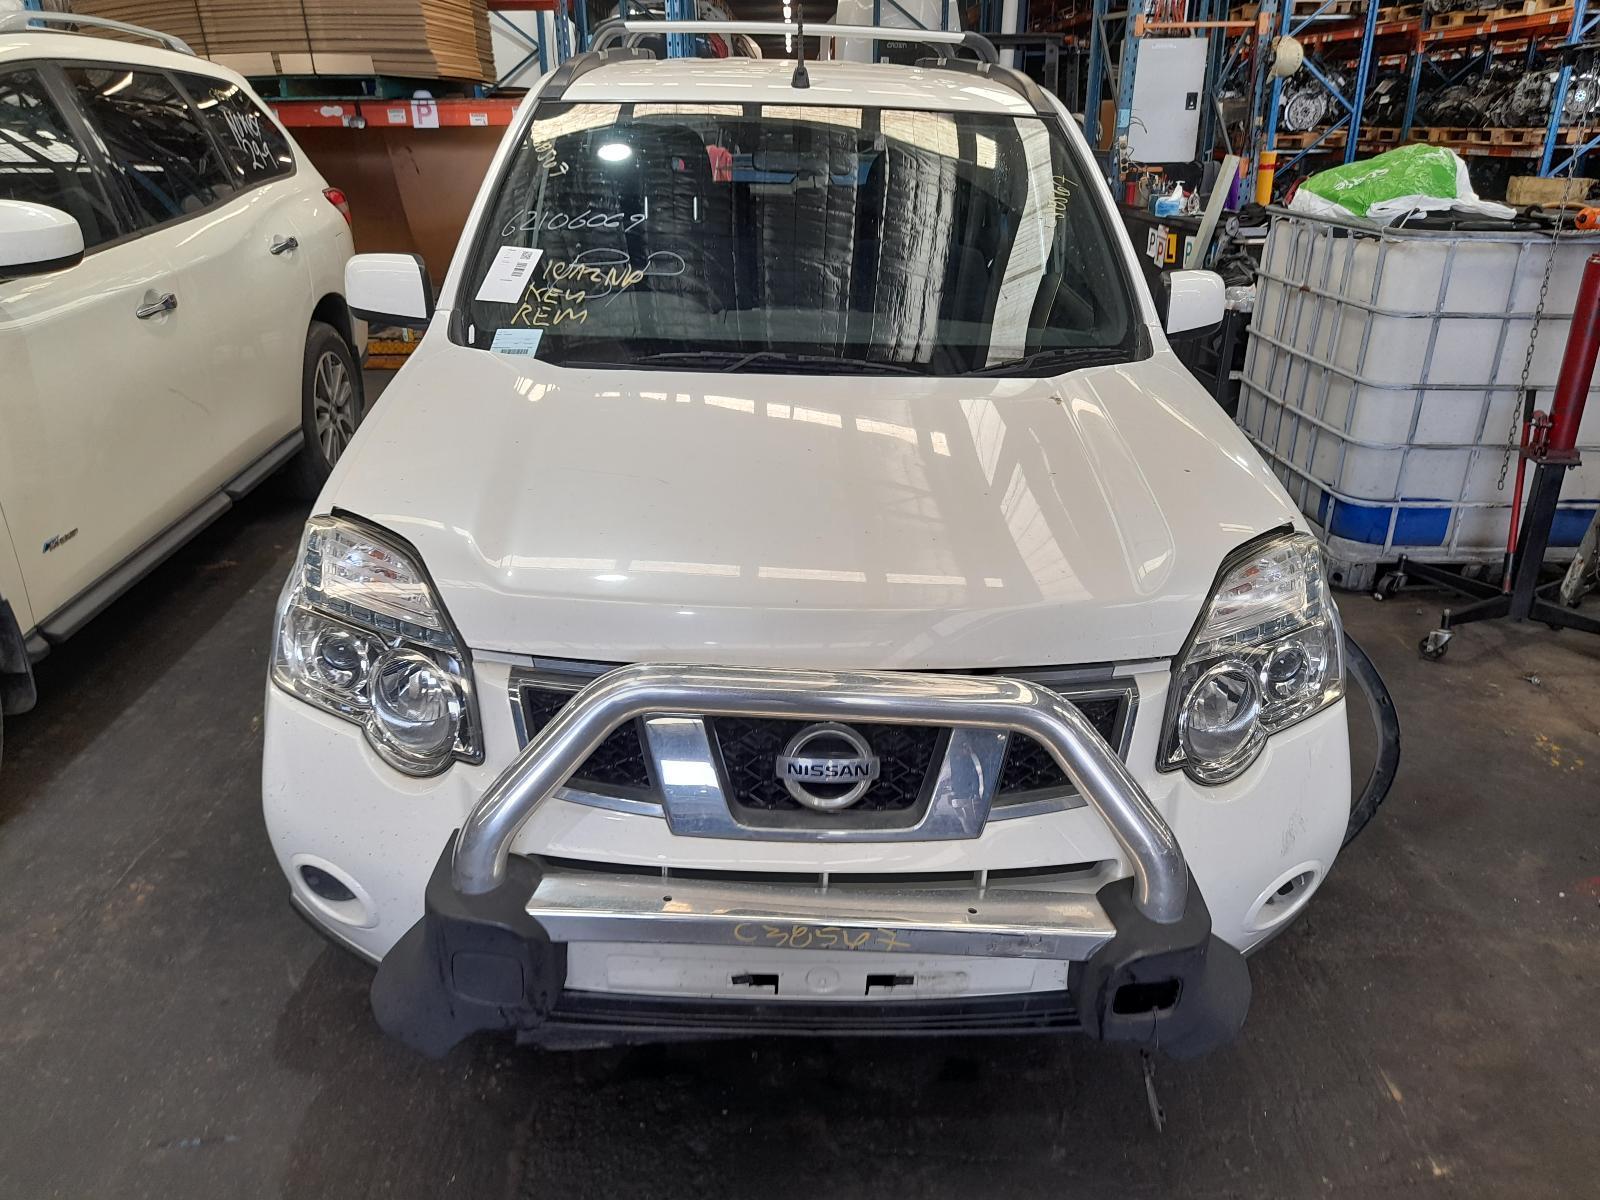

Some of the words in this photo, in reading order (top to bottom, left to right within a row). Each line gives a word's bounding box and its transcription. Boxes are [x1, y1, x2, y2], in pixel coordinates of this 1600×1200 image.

[416, 104, 432, 125] P
[787, 762, 869, 778] NISSAN
[734, 923, 911, 952] C38567
